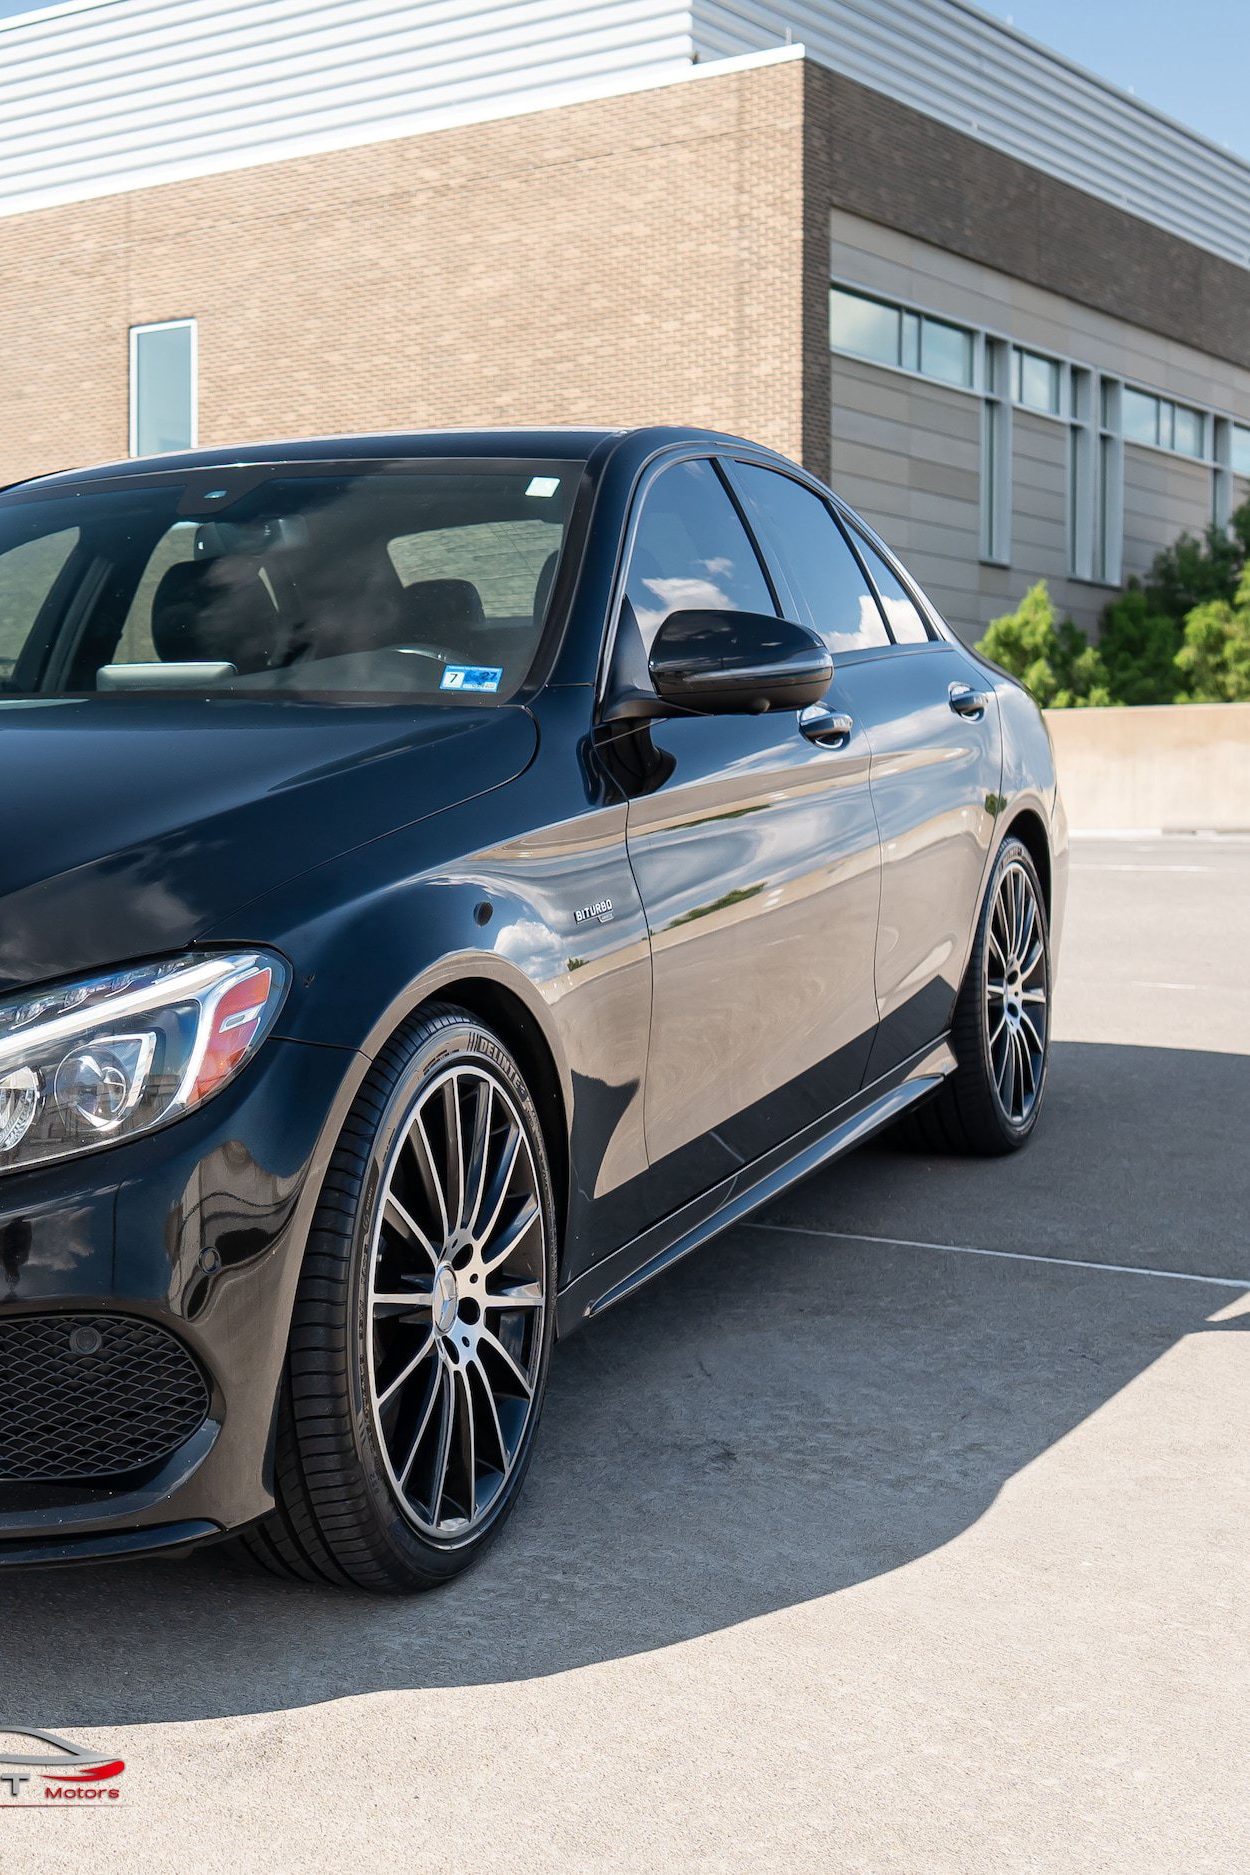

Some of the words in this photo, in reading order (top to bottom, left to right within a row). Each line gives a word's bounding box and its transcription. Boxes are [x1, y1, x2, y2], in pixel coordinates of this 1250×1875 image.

[449, 673, 458, 683] 7
[575, 899, 613, 921] BITURBO
[479, 1039, 521, 1087] DELINTE
